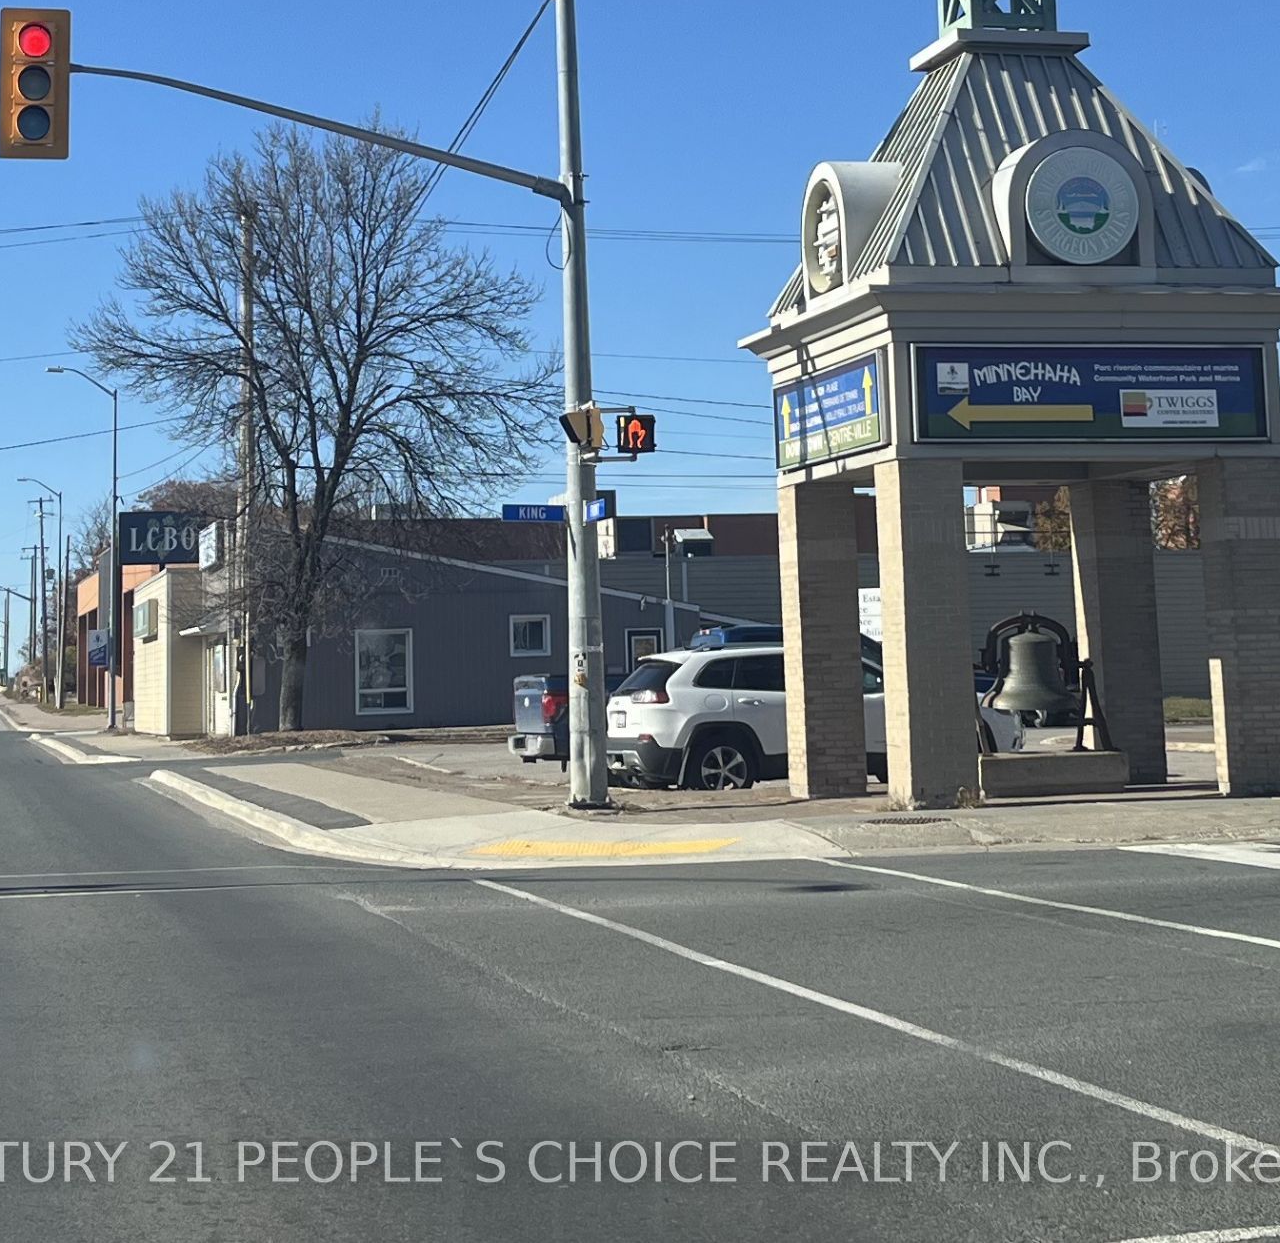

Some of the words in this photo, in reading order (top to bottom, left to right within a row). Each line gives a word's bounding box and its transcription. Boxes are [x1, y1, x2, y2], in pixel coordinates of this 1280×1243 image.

[972, 361, 1081, 387] MINNEHAHA
[1093, 374, 1136, 383] Community
[1138, 374, 1178, 382] Waterfront
[1179, 374, 1197, 382] Park
[1198, 374, 1213, 382] and
[1214, 374, 1241, 382] Marina
[1013, 386, 1042, 402] BAY
[1154, 396, 1215, 408] TWIGGS
[519, 506, 547, 519] KING
[129, 526, 196, 552] LCBO
